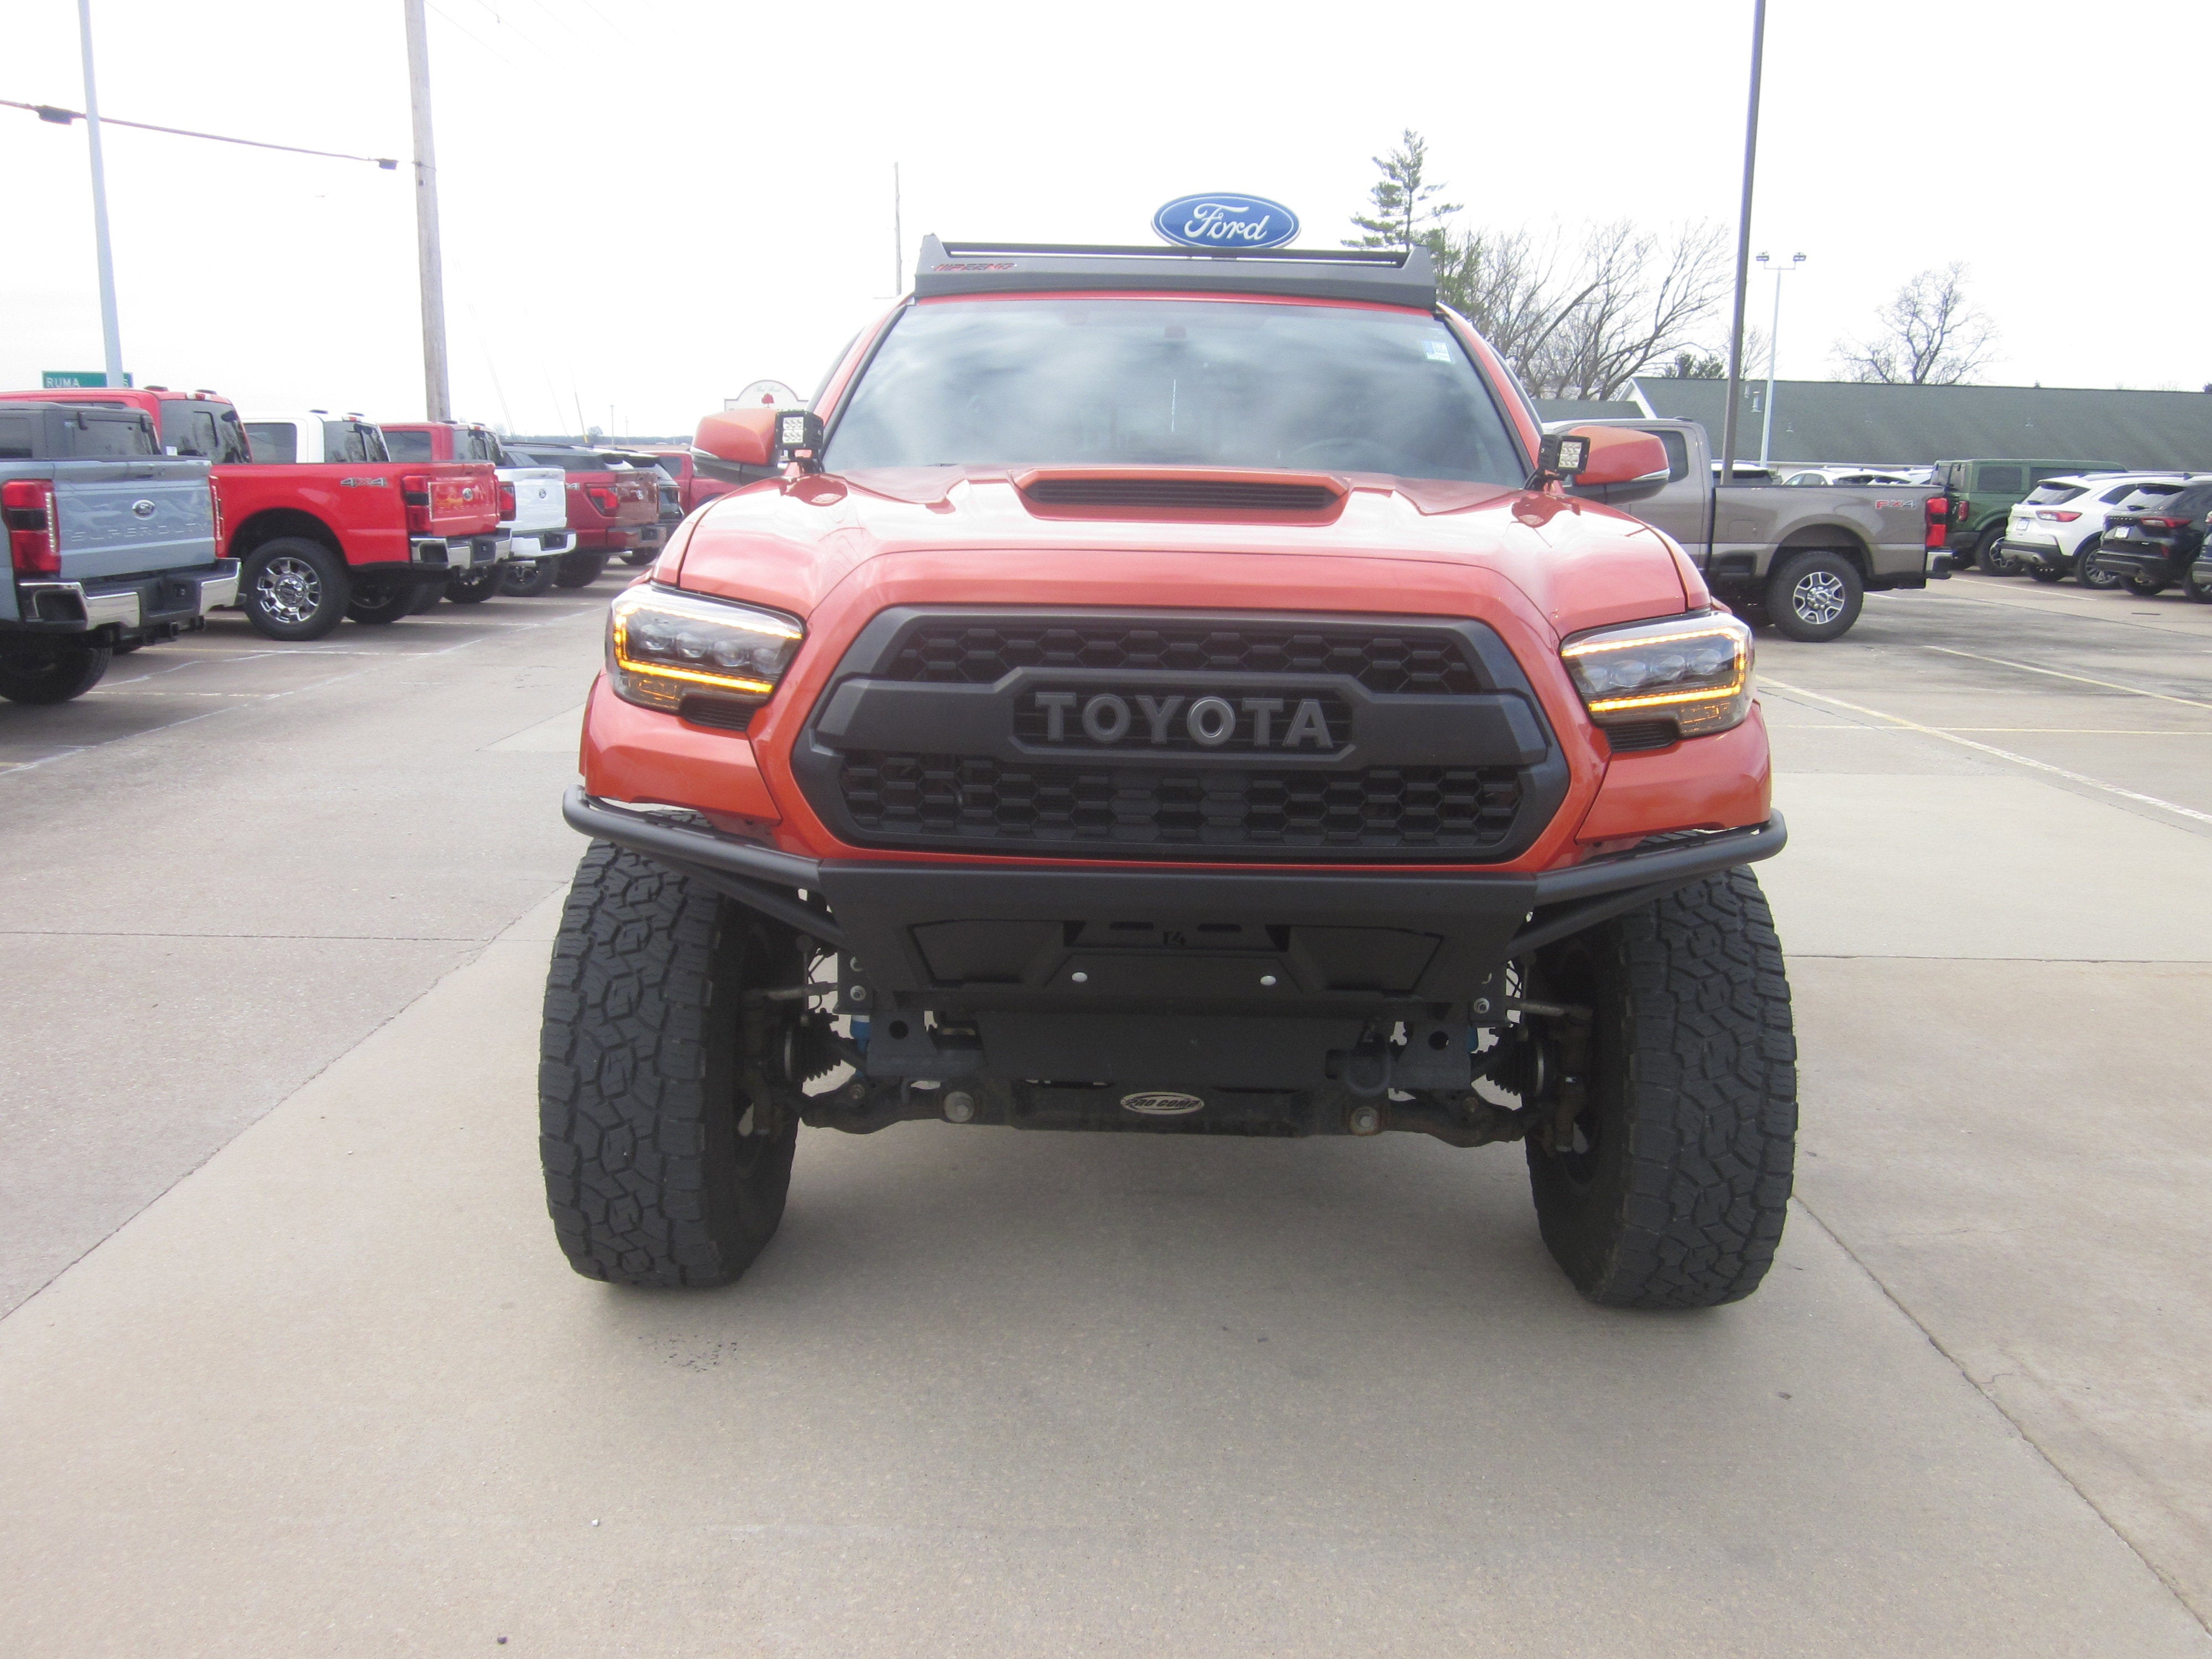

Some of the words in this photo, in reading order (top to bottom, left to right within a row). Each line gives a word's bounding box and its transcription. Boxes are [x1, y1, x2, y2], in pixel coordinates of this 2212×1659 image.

[1185, 203, 1270, 240] Ford
[46, 377, 81, 387] RUMA
[1875, 500, 1916, 509] FX4
[1035, 692, 1333, 748] TOYOTA
